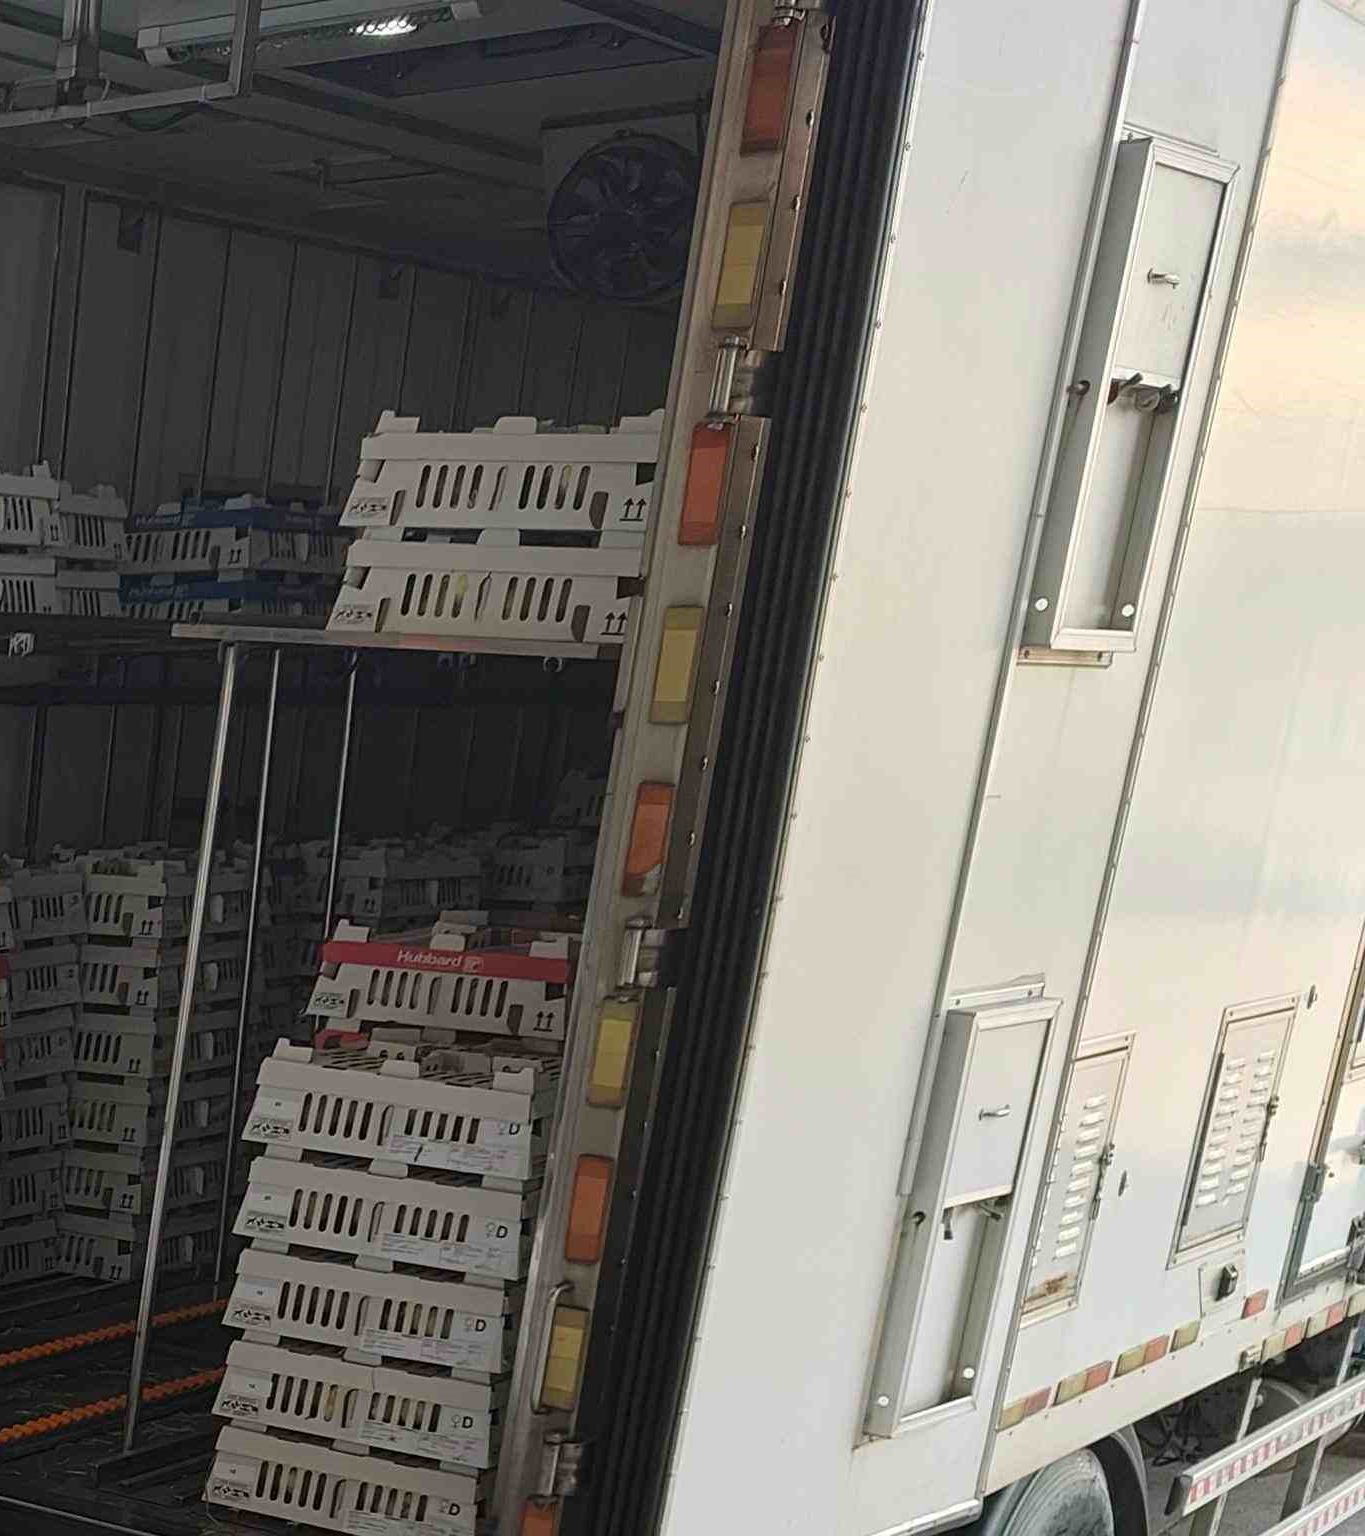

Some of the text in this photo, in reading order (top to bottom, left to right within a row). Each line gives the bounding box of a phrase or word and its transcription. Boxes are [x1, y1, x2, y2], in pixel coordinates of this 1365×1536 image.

[397, 950, 462, 968] Hubbard
[496, 1225, 508, 1239] D
[475, 1319, 487, 1332] D
[462, 1415, 474, 1429] D
[448, 1503, 461, 1516] D
